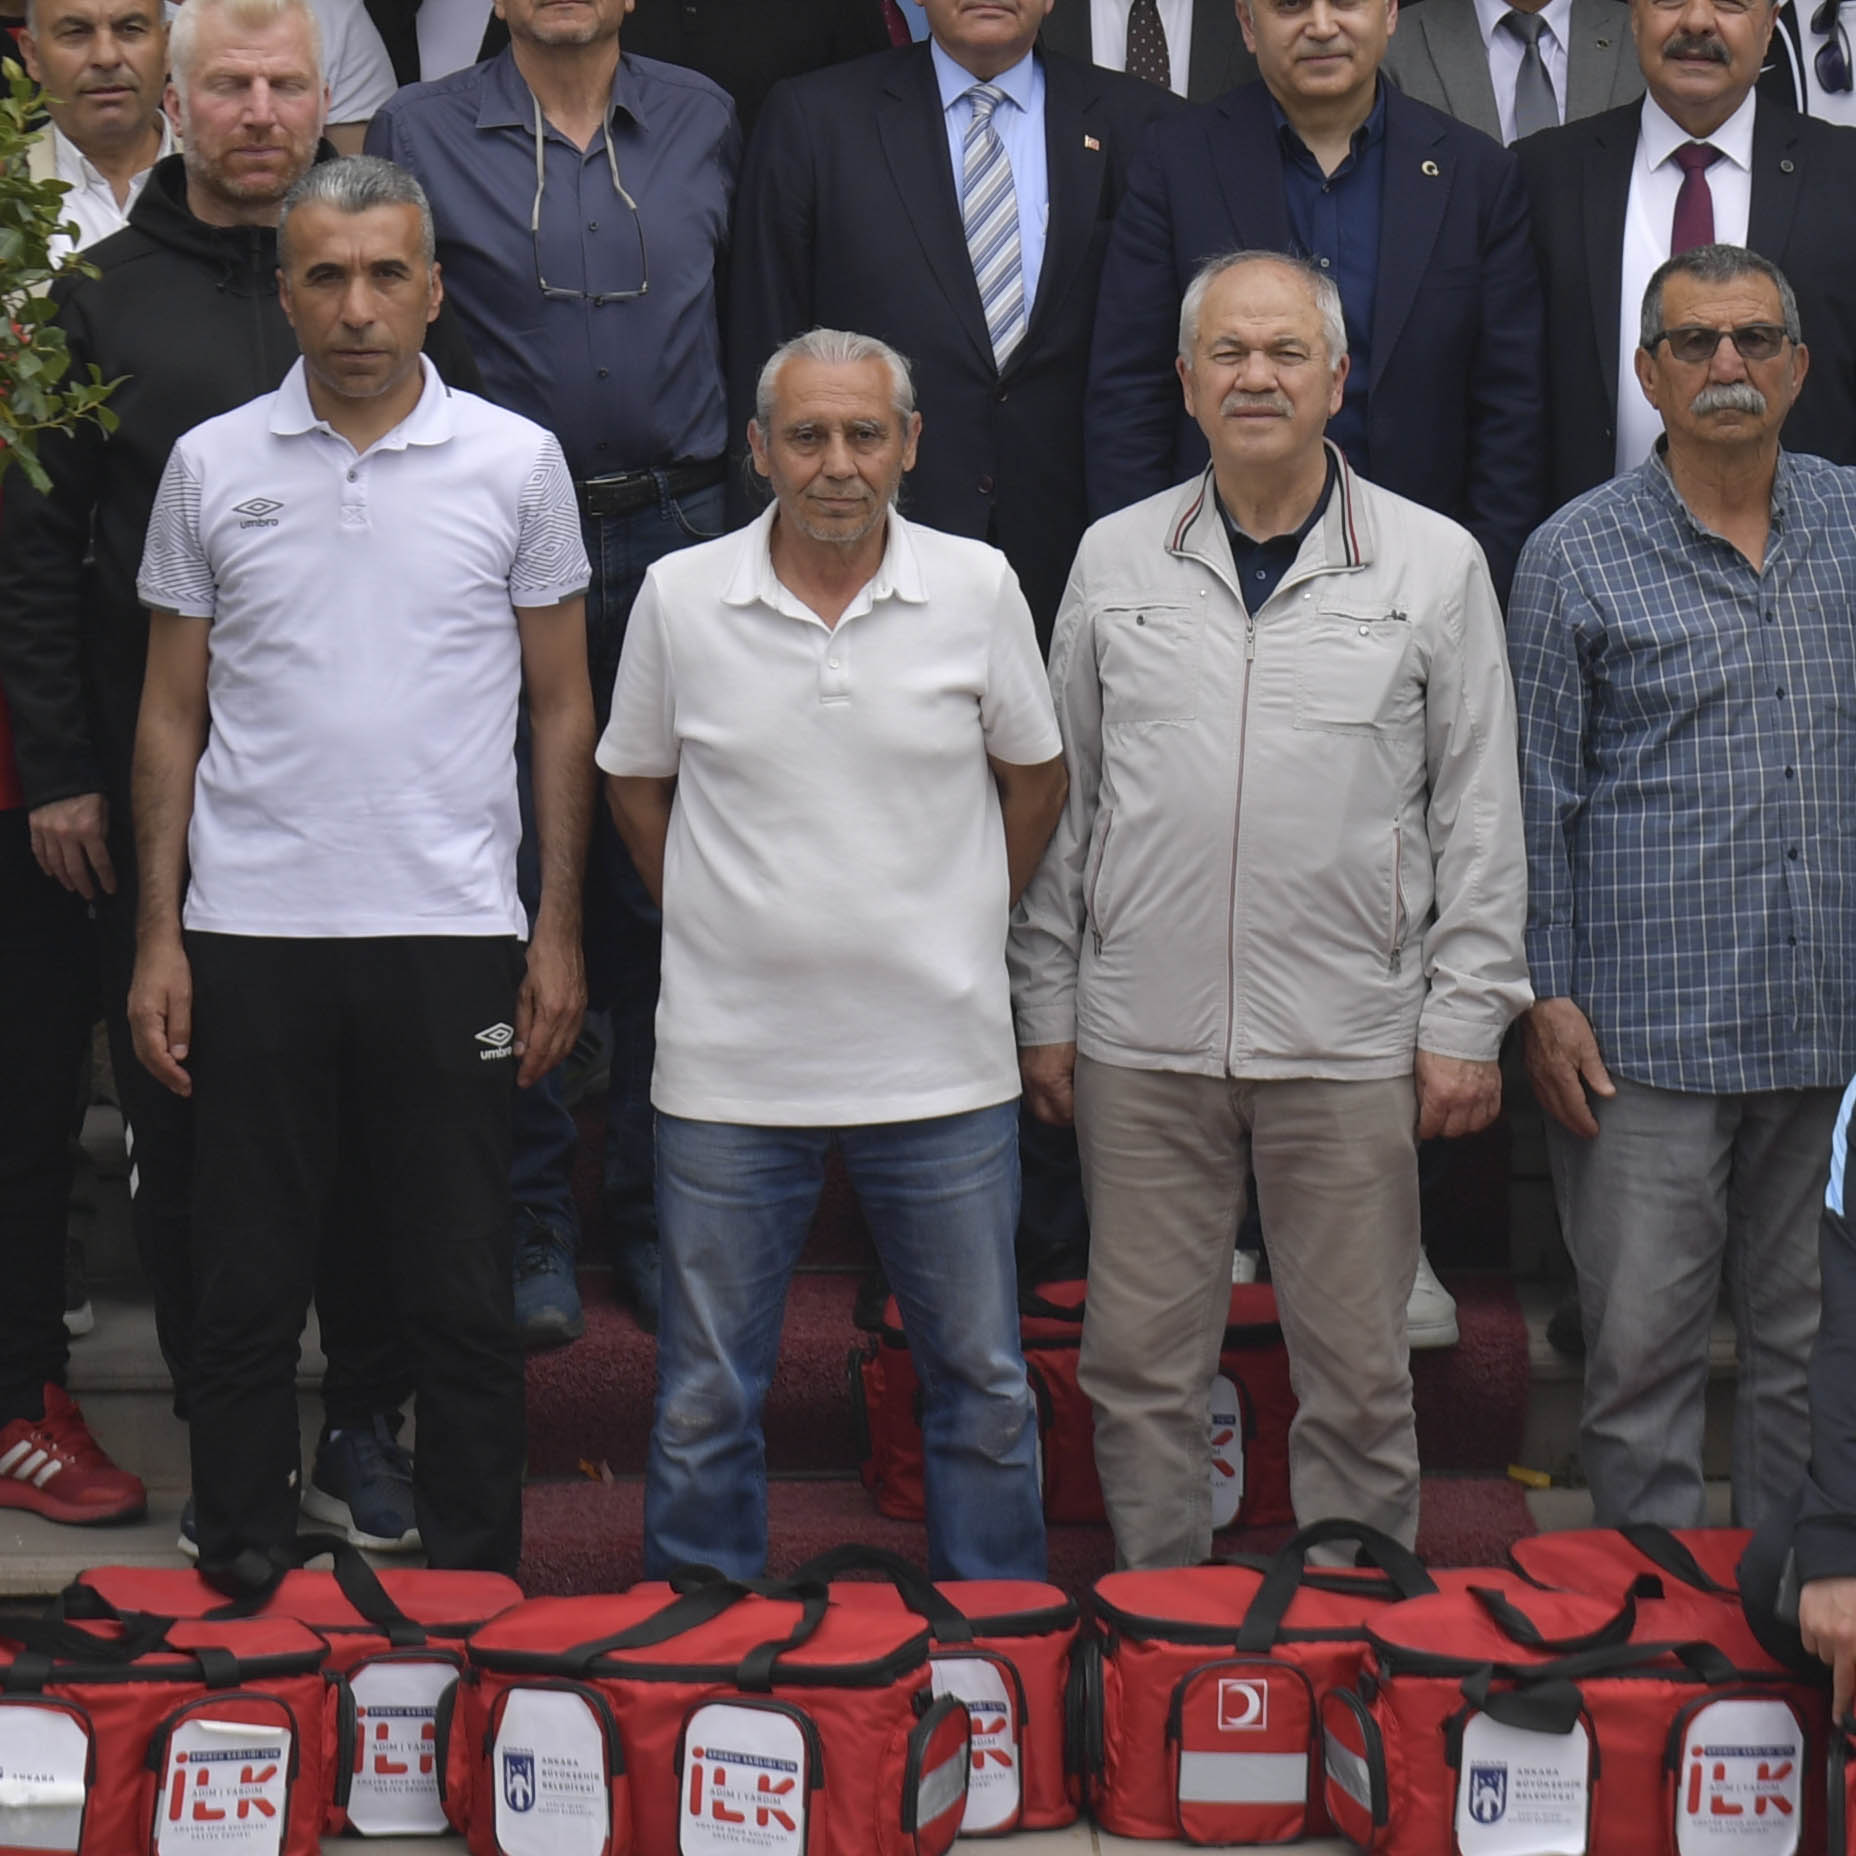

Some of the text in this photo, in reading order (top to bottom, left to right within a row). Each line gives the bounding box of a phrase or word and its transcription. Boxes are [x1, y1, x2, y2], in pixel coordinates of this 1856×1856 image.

[168, 1751, 278, 1822] İLK
[690, 1746, 797, 1833] İLK
[1686, 1743, 1793, 1817] İLK
